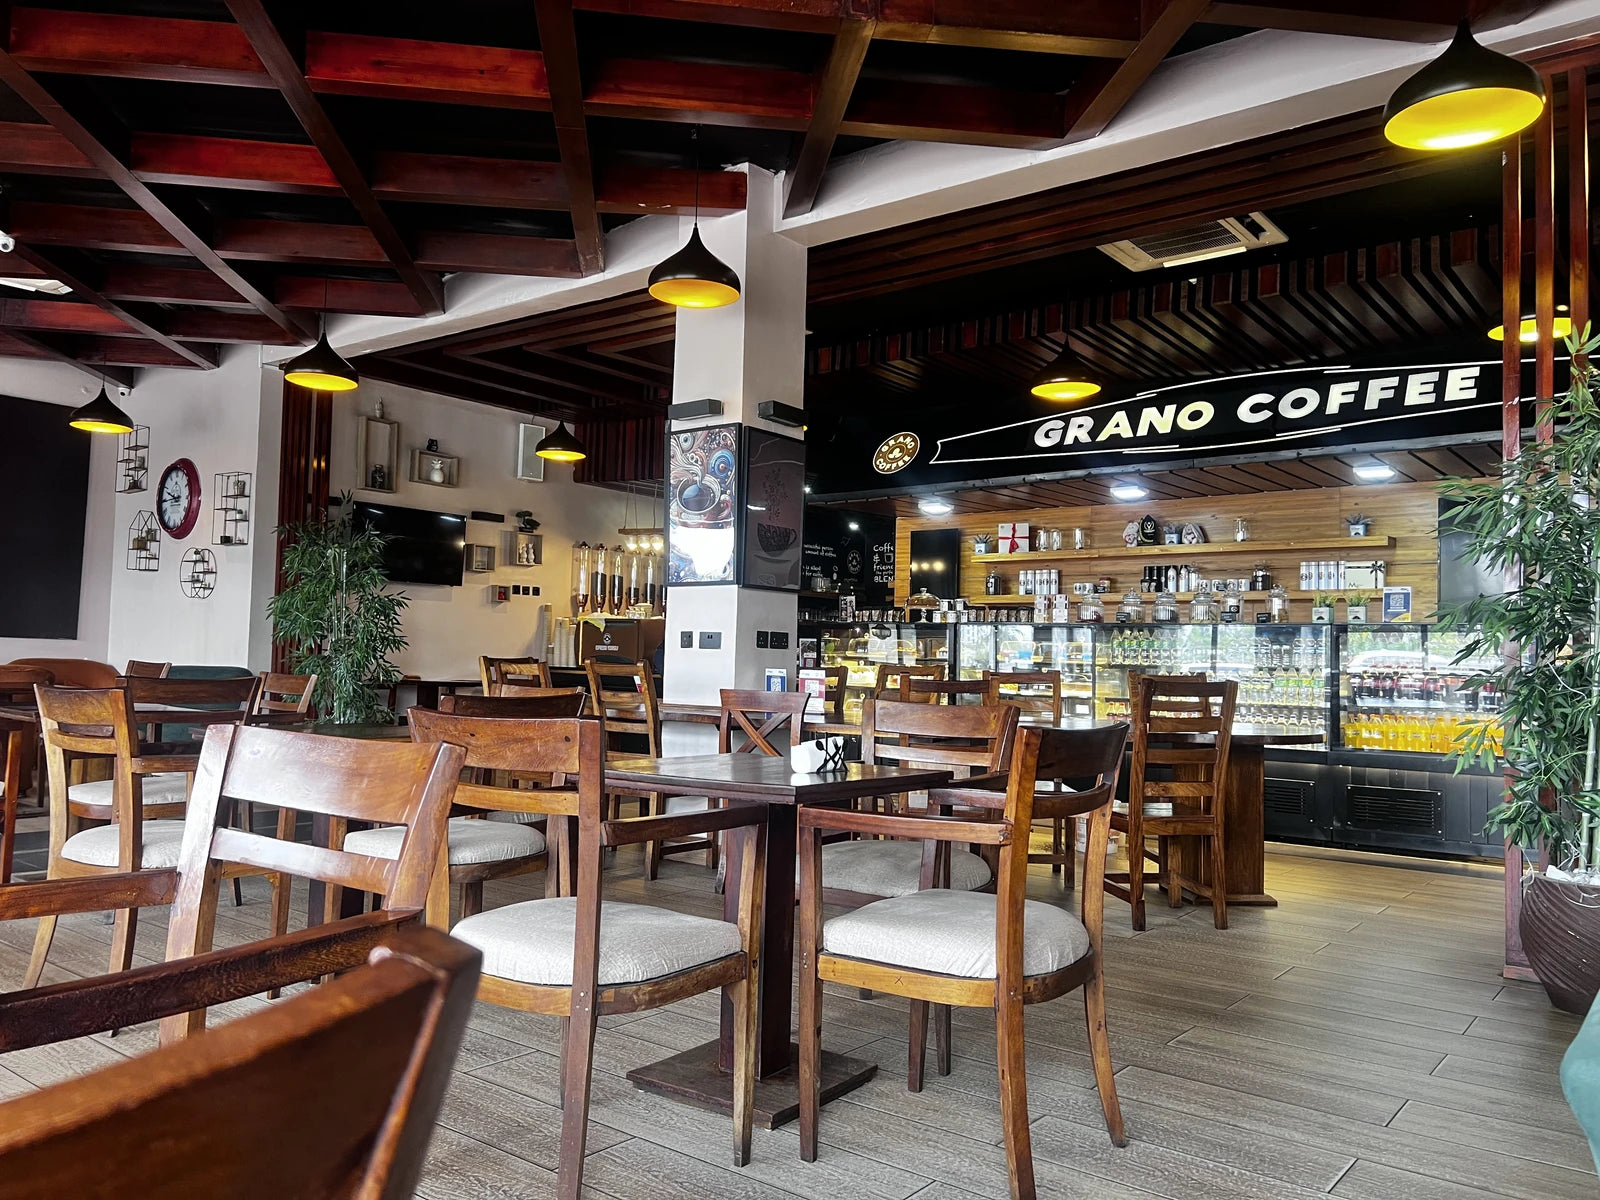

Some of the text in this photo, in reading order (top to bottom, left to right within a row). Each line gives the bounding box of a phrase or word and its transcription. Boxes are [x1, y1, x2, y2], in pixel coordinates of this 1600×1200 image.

[1034, 366, 1481, 448] GRANO COFFEE
[881, 436, 915, 452] GRANO
[876, 455, 911, 471] COFFEE
